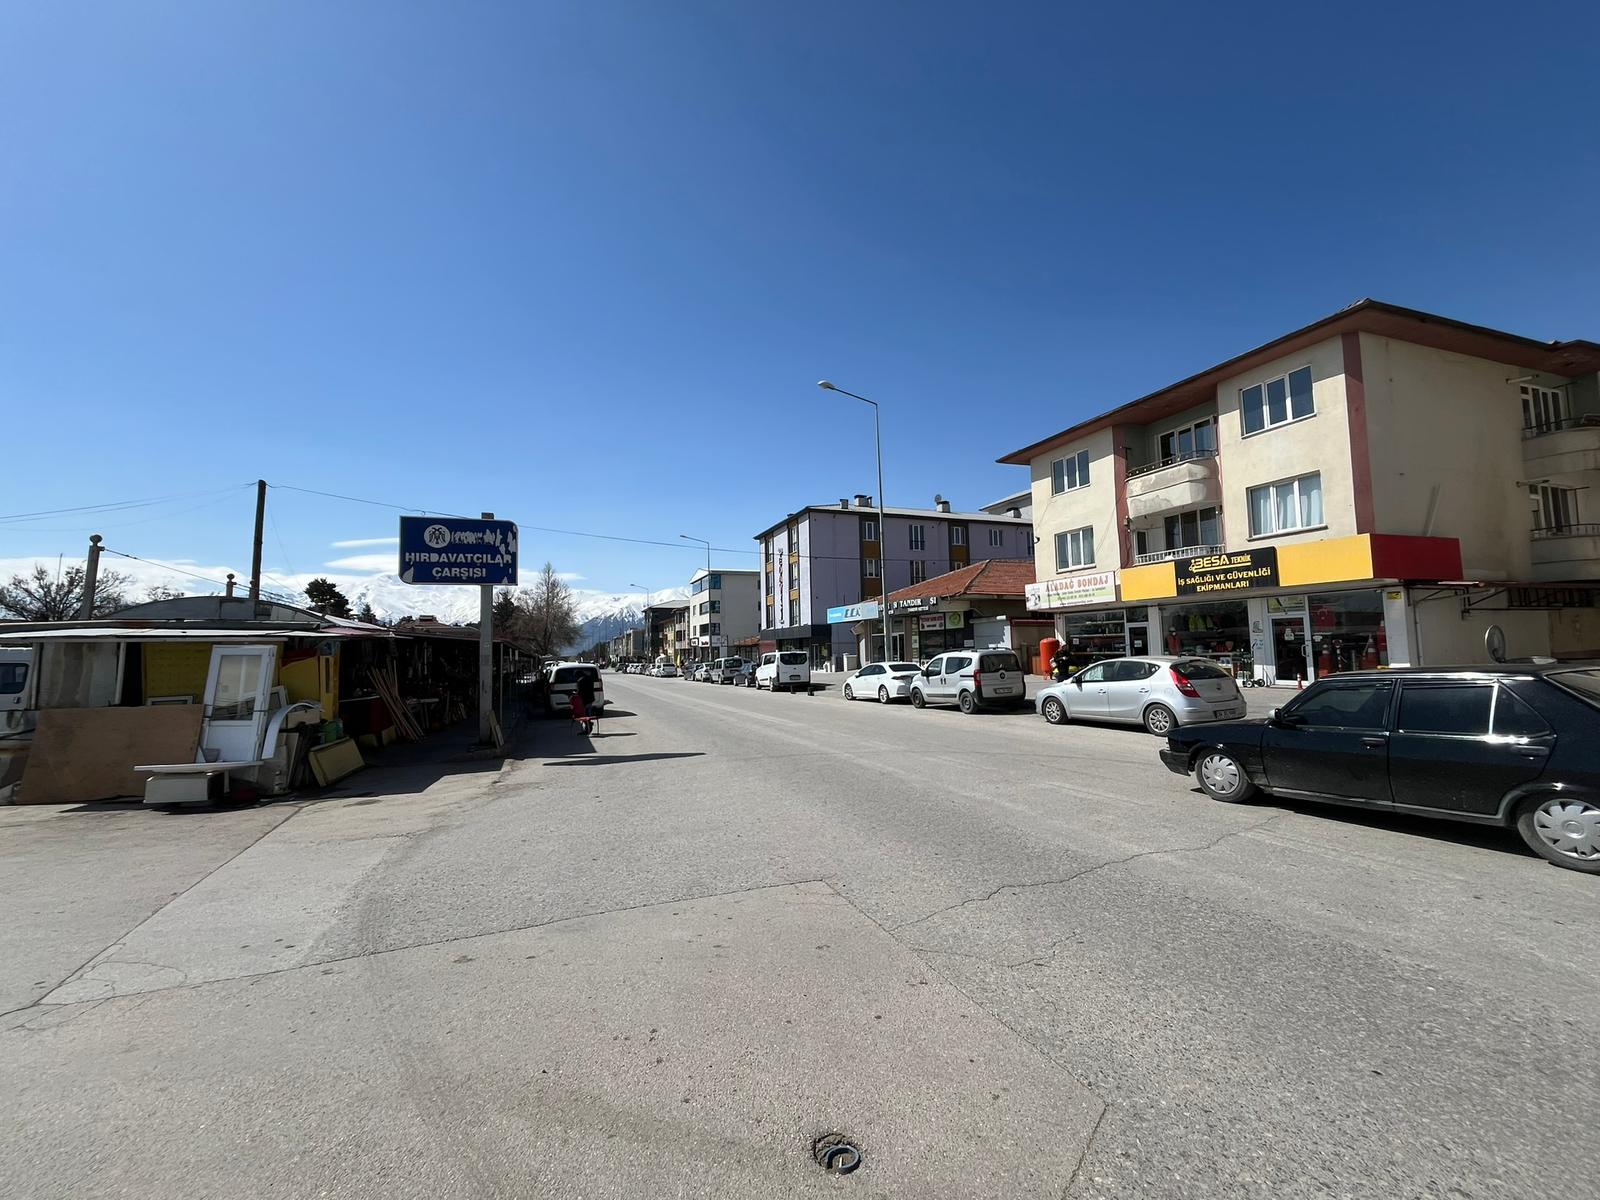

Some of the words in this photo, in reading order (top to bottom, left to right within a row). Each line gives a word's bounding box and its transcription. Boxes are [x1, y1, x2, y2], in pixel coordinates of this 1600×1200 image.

[405, 552, 511, 566] HIRDAVATÇILAR
[1192, 555, 1230, 569] BESA
[432, 567, 486, 579] ÇARŞISI
[1178, 577, 1185, 586] İŞ
[1186, 573, 1214, 585] SAĞLIĞI
[1226, 566, 1271, 580] GÜVENLİĞİ
[1078, 575, 1109, 588] SONDAJ
[1196, 581, 1249, 592] EKİPMANLARI
